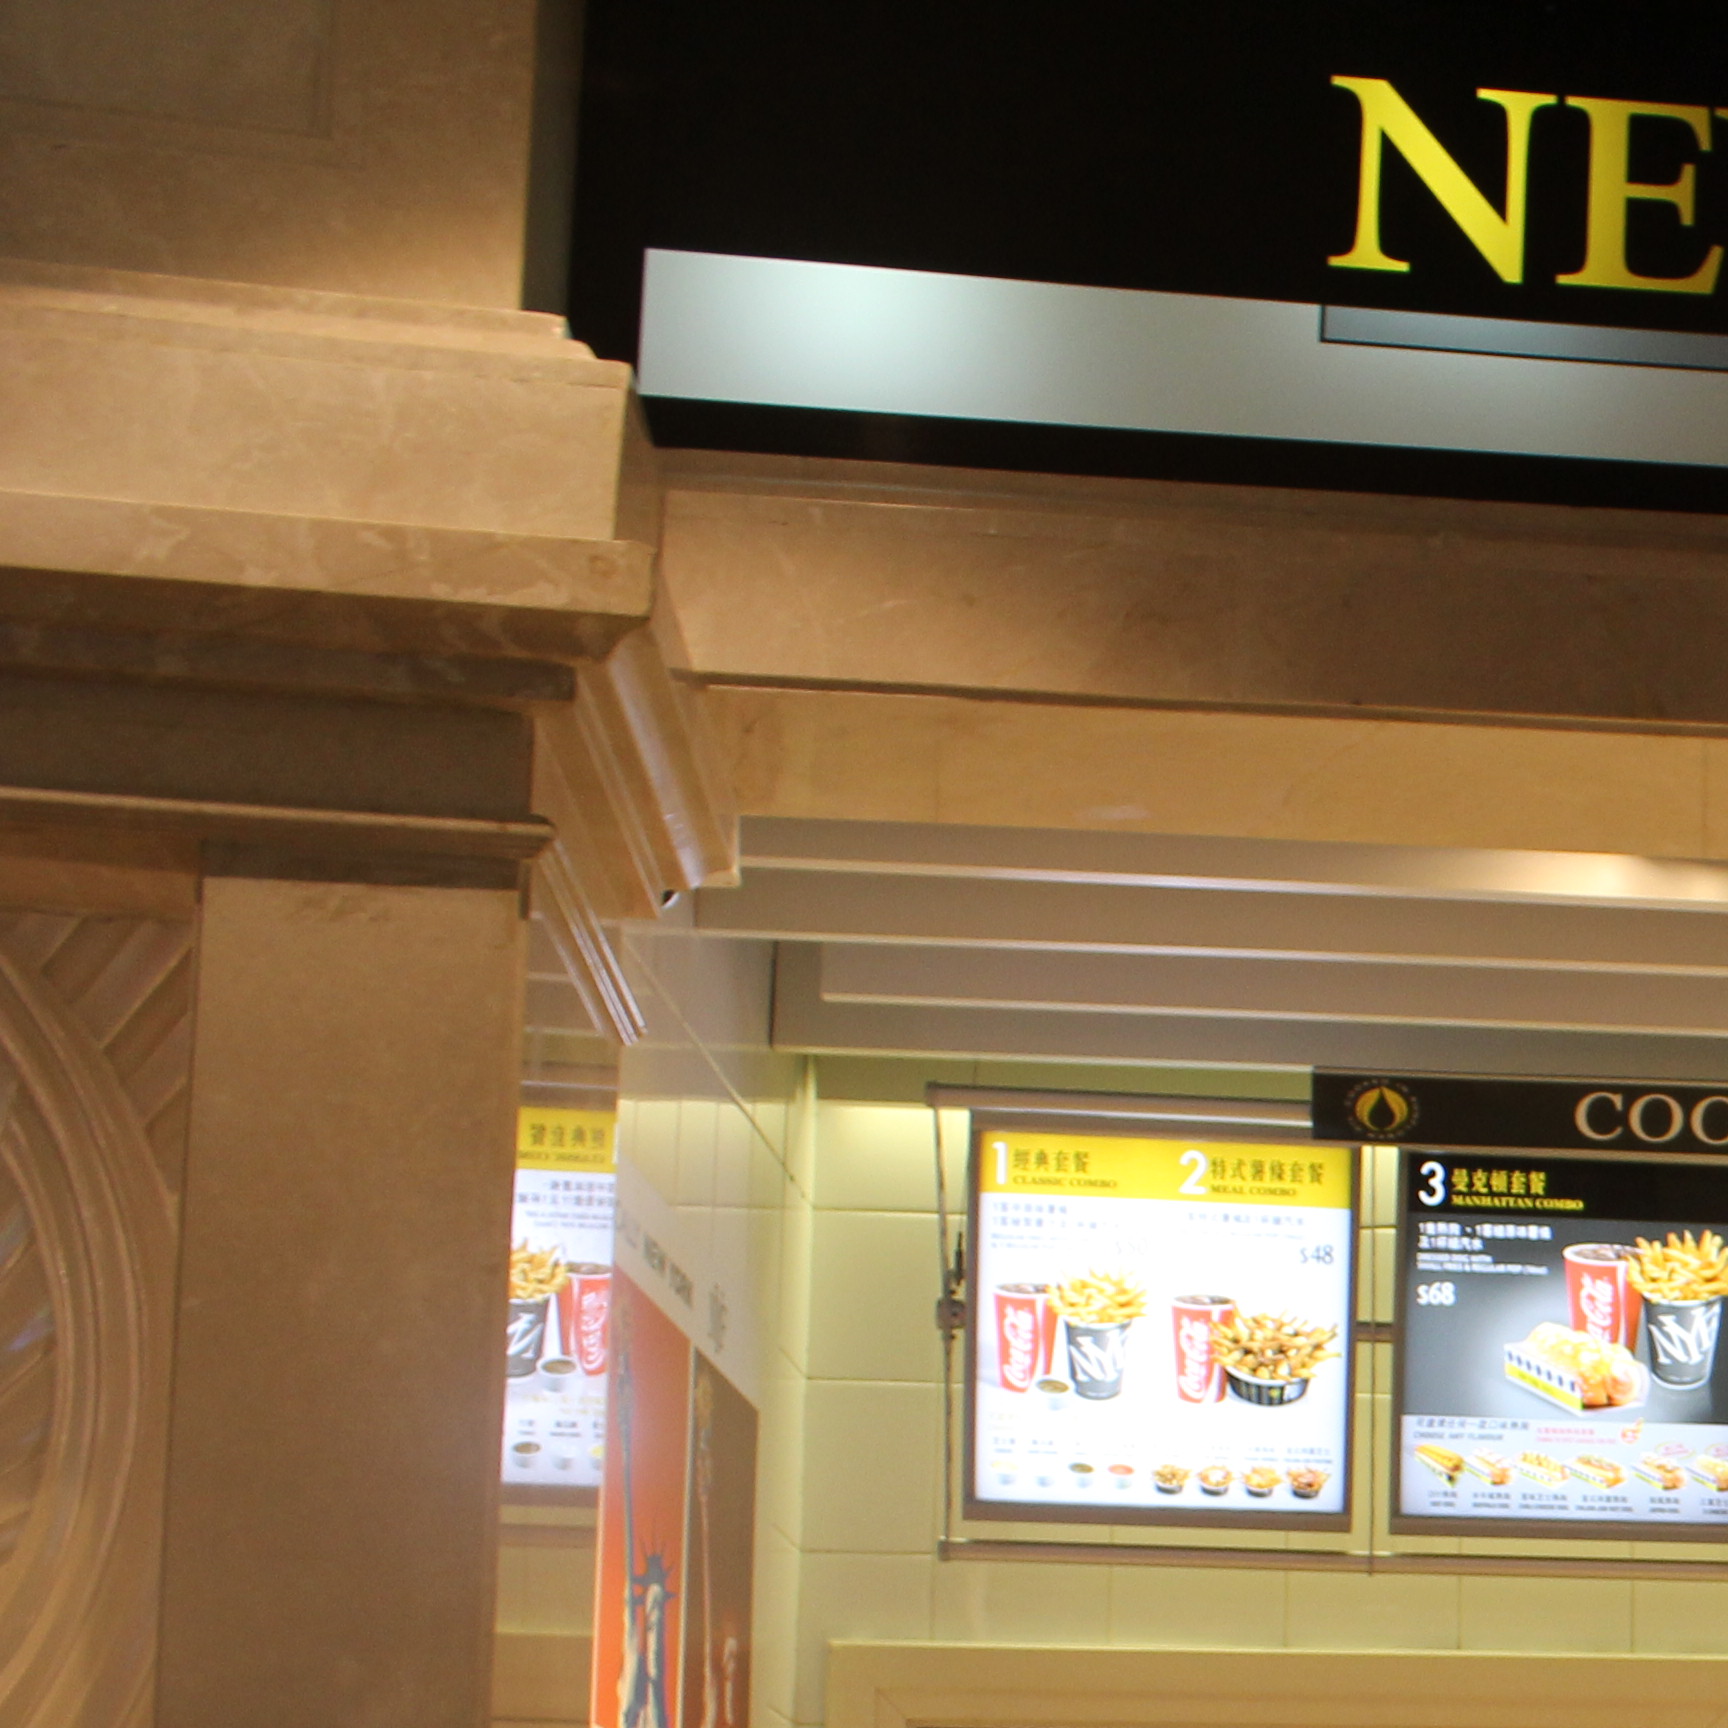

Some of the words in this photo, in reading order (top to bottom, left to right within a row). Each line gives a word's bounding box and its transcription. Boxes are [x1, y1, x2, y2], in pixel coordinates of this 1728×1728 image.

[993, 1141, 1008, 1185] 1
[1178, 1150, 1207, 1195] 2
[1418, 1161, 1447, 1207] 3
[1451, 1195, 1534, 1210] MANHATTAN
[1536, 1198, 1585, 1212] COMBO
[1299, 1244, 1335, 1265] $48
[1416, 1282, 1457, 1307] $68
